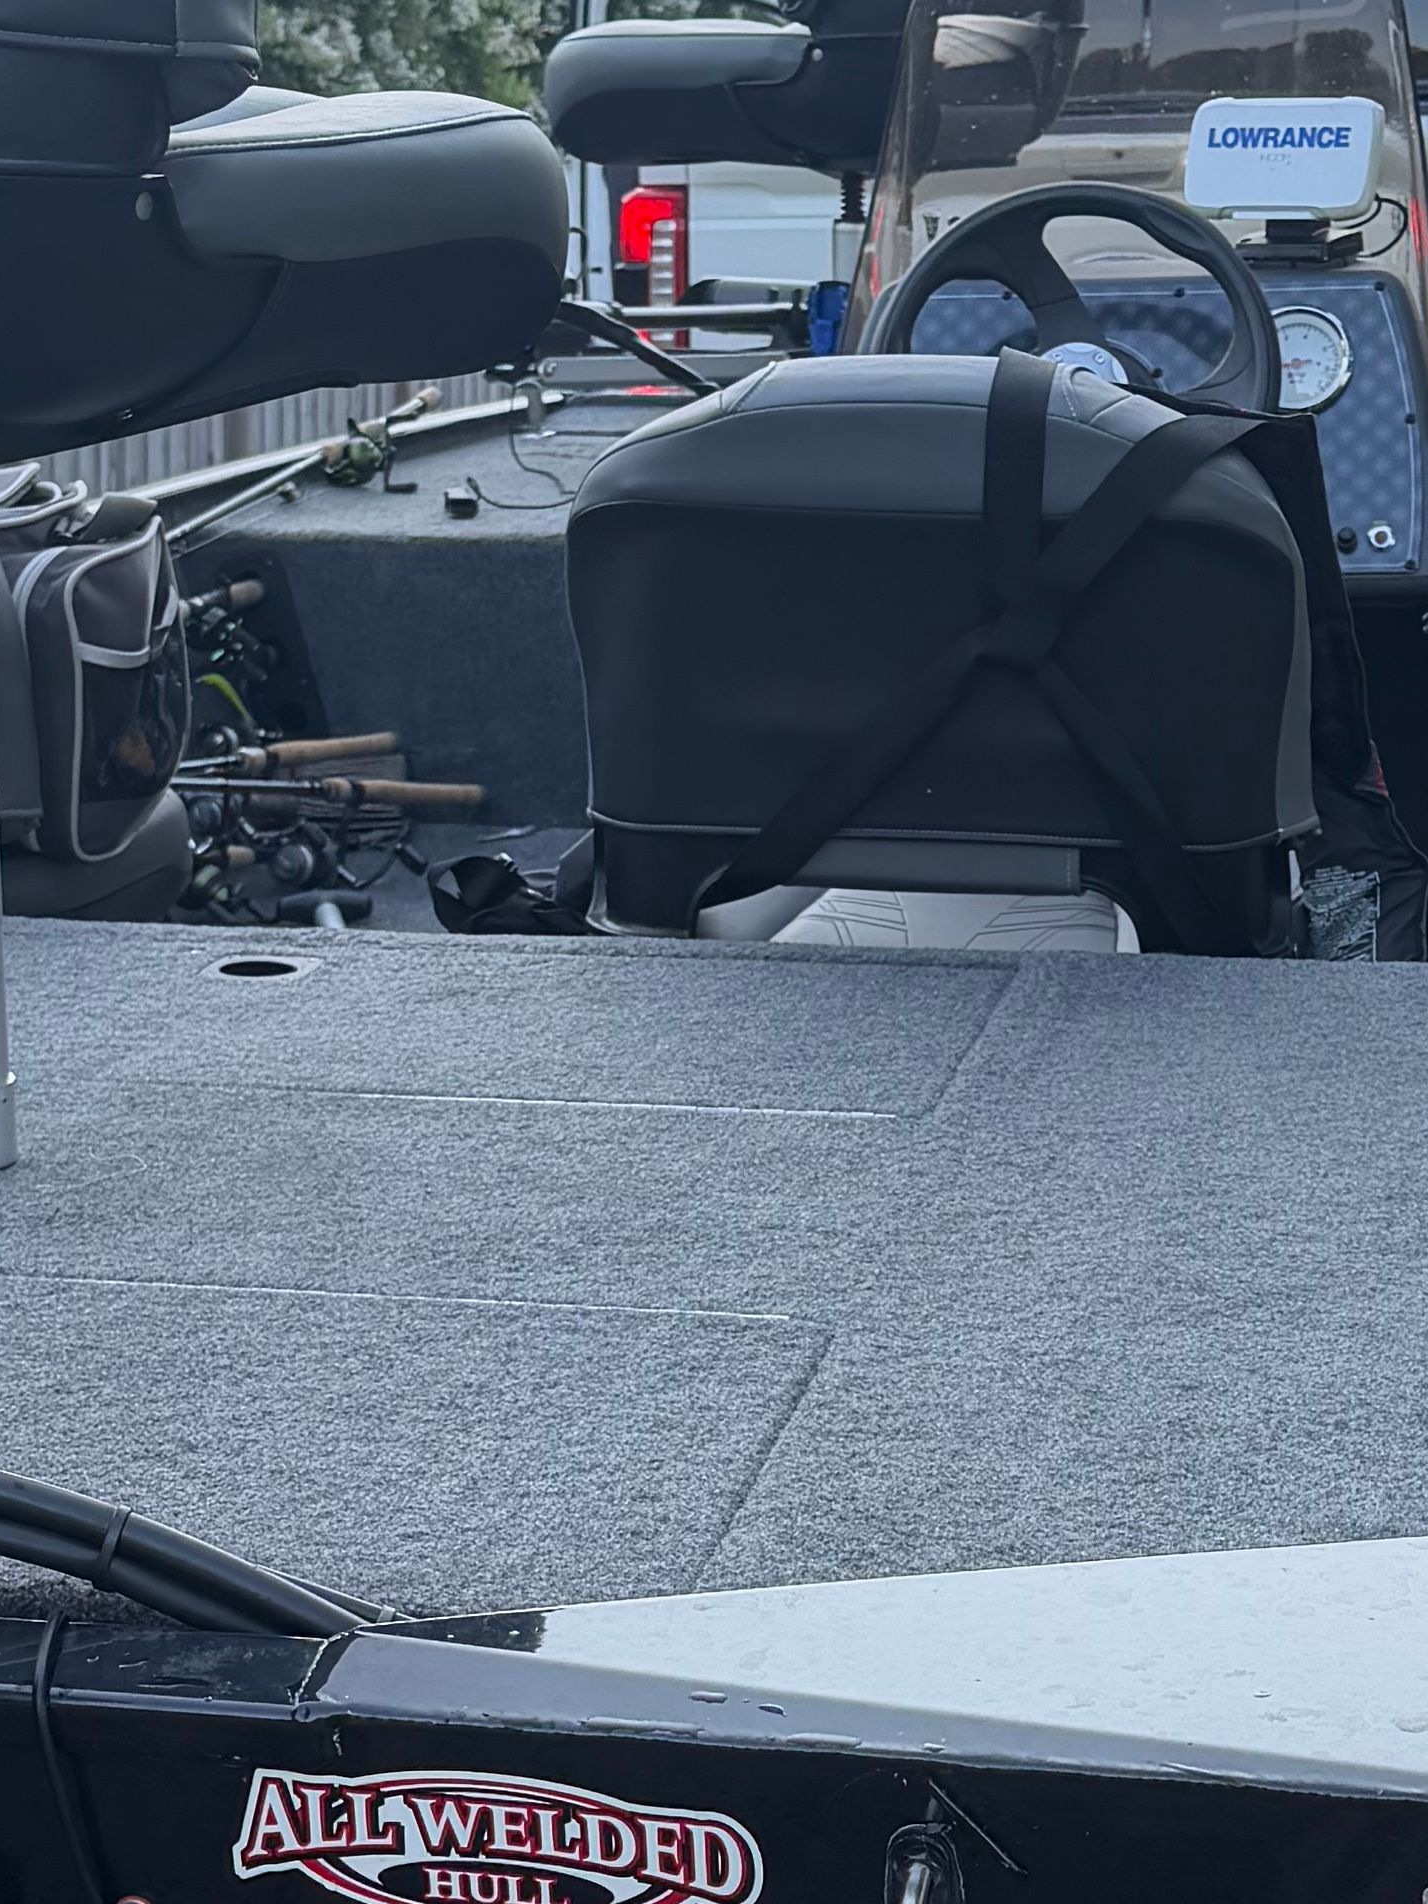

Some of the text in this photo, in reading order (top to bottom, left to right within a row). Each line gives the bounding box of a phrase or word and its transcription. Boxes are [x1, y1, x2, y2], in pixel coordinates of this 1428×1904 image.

[1207, 127, 1352, 149] LOWRANCE
[243, 1781, 743, 1900] ALL WELDED
